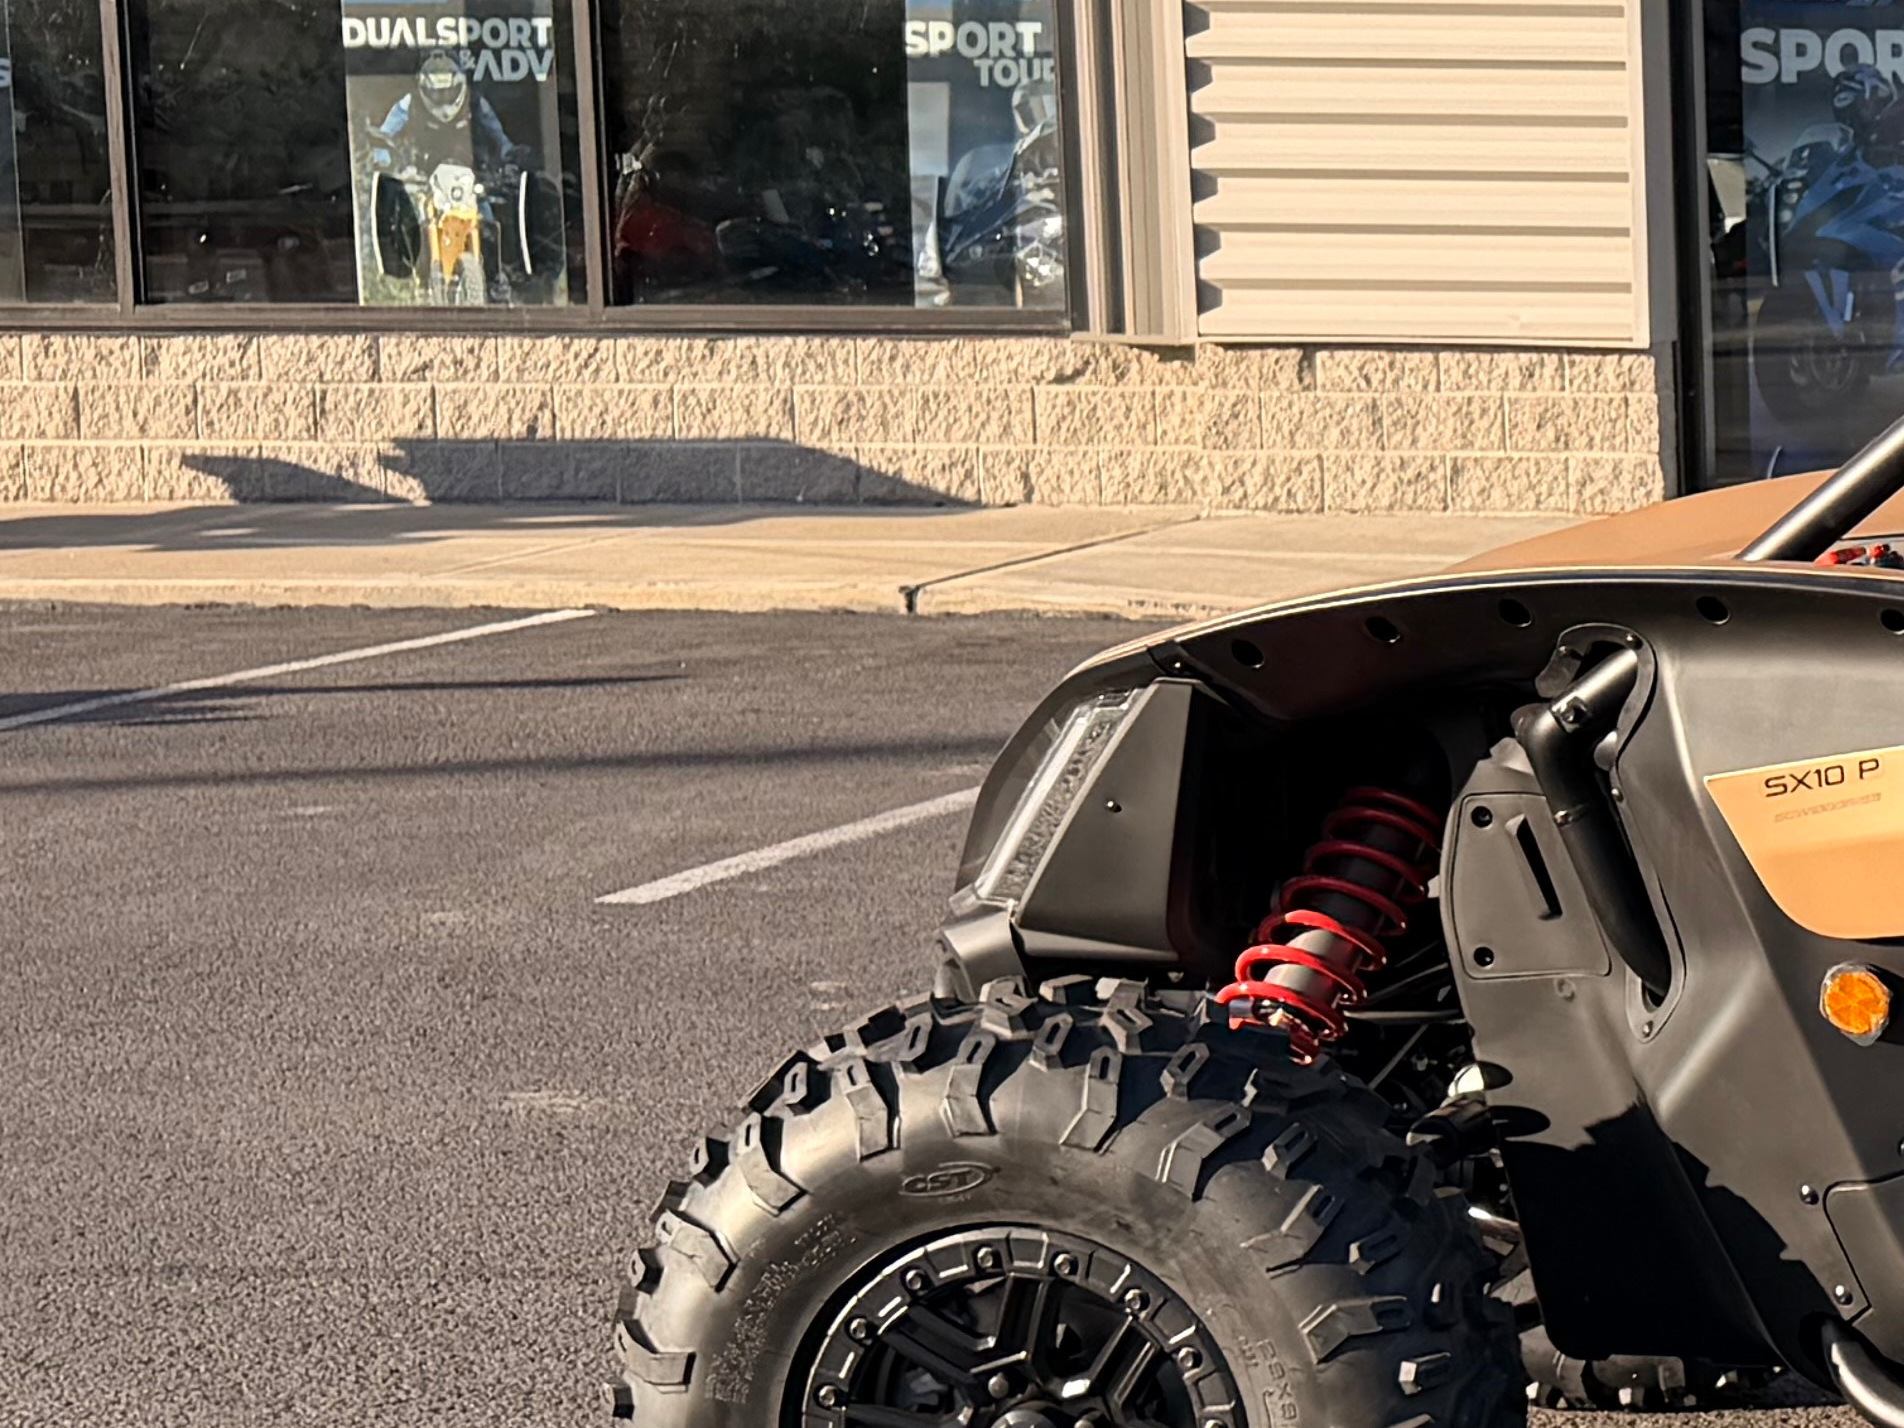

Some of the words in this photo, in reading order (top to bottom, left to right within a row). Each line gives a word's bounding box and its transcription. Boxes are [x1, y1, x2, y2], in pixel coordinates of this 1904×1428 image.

[341, 16, 554, 49] DUALSPORT
[905, 20, 1043, 59] SPORT
[1763, 764, 1846, 798] SX10
[1858, 757, 1880, 781] P
